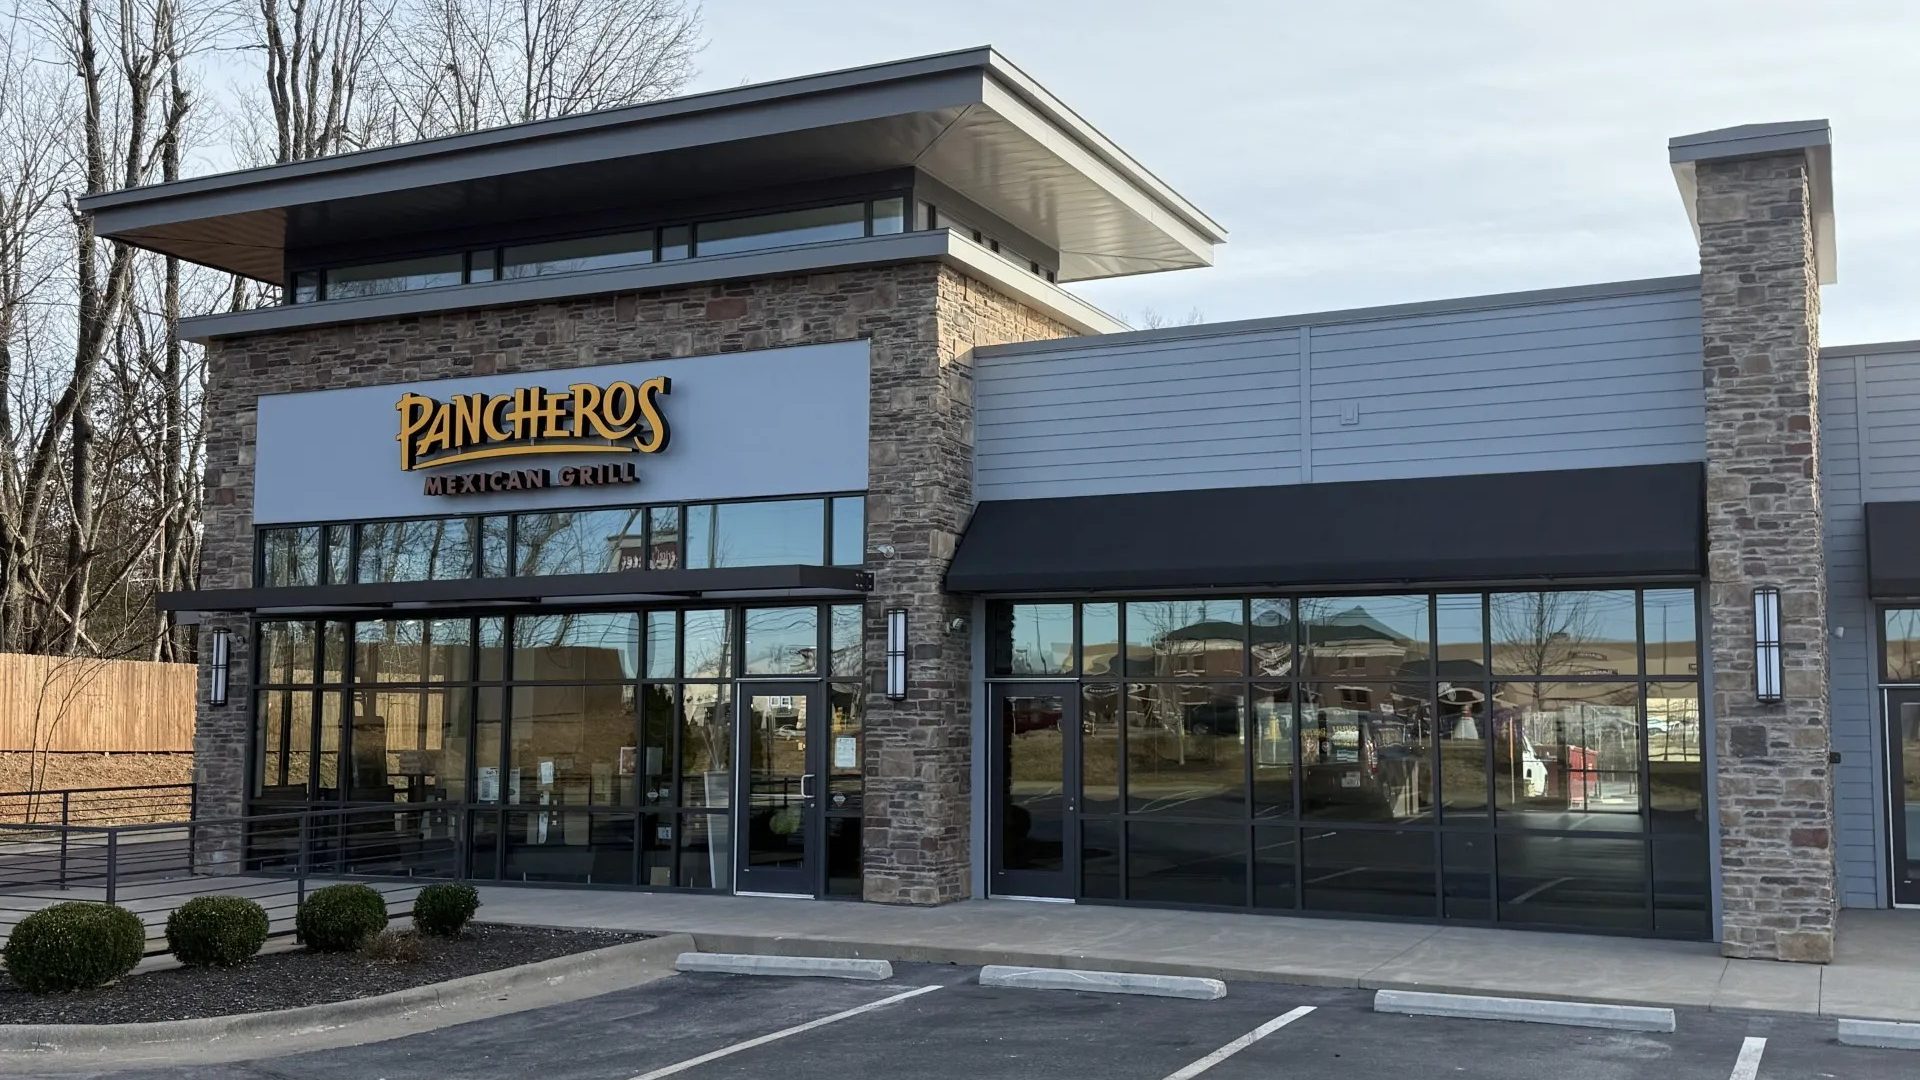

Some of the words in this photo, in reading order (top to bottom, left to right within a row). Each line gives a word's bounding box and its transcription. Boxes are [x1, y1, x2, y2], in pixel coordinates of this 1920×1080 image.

[395, 376, 671, 471] PANCHEROS
[424, 469, 550, 496] MEXICAN
[558, 462, 640, 487] GRILL
